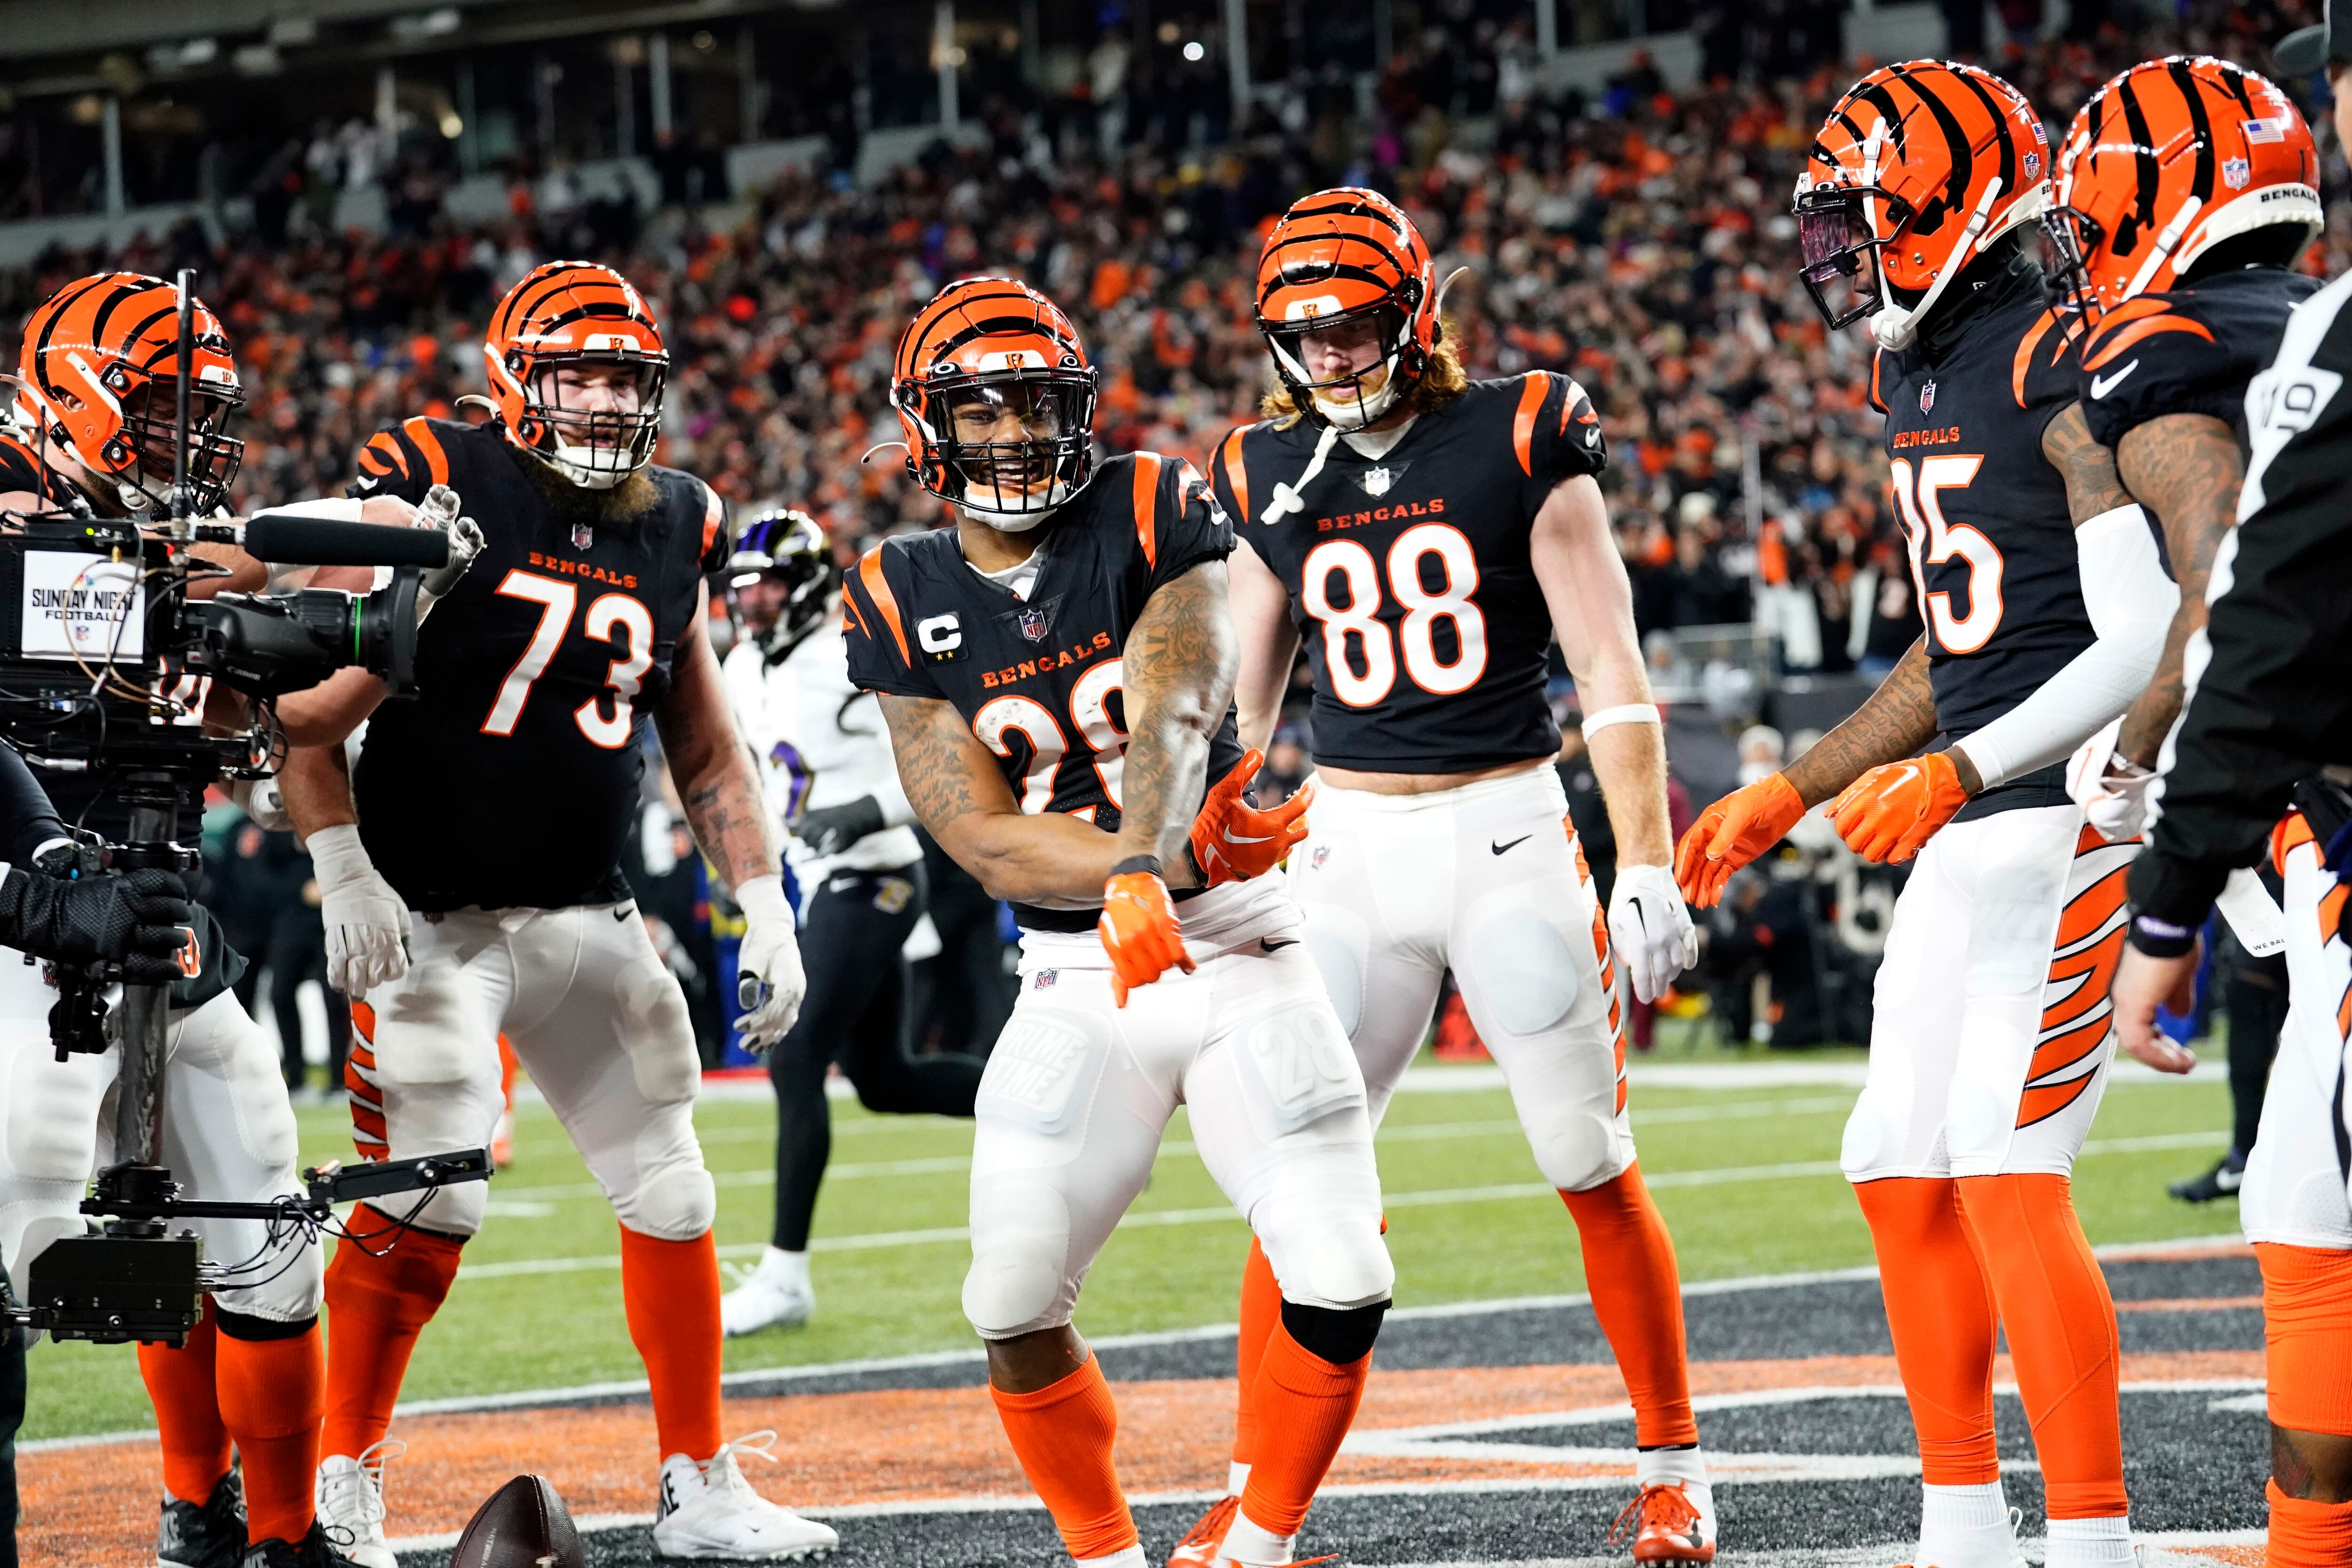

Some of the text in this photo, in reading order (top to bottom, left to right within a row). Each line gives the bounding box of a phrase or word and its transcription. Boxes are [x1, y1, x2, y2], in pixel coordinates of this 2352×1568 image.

[1893, 427, 1960, 448] BENGALS
[1317, 498, 1446, 532] BENGALS
[529, 552, 638, 589] BENGALS
[32, 589, 87, 608] SUNDAY
[46, 610, 123, 622] FOOTBALL
[1301, 521, 1489, 708] 88
[917, 614, 962, 653] C
[479, 568, 656, 749] 73
[981, 631, 1112, 689] BENGALS
[1257, 1011, 1353, 1106] 28
